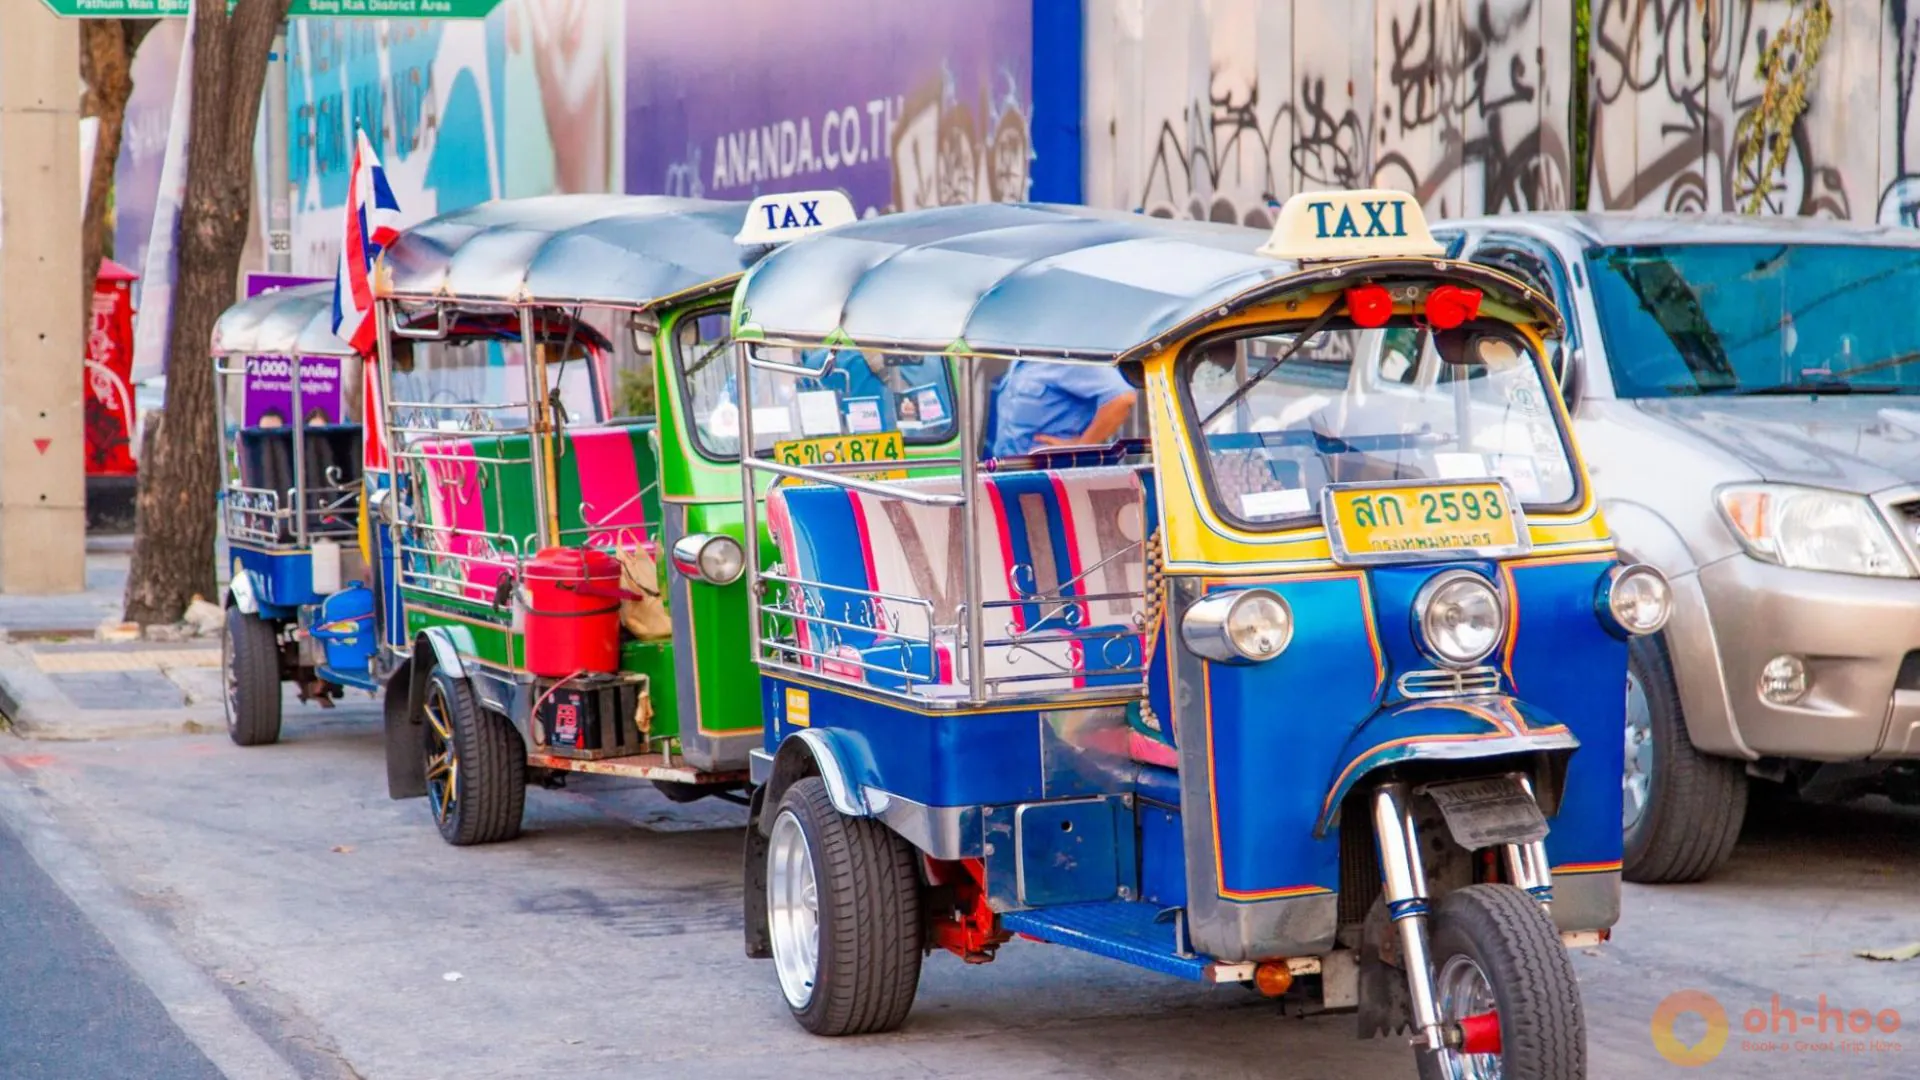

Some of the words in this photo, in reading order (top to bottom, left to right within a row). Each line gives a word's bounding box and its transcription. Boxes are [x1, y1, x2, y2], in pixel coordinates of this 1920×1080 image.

[368, 0, 416, 11] District
[420, 0, 451, 12] Area
[712, 94, 905, 190] ANANDA.CO.TH
[761, 200, 823, 230] TAX
[1307, 200, 1408, 238] TAXI
[836, 436, 899, 465] 1874
[1351, 494, 1404, 528] สก
[1419, 490, 1503, 525] 2593
